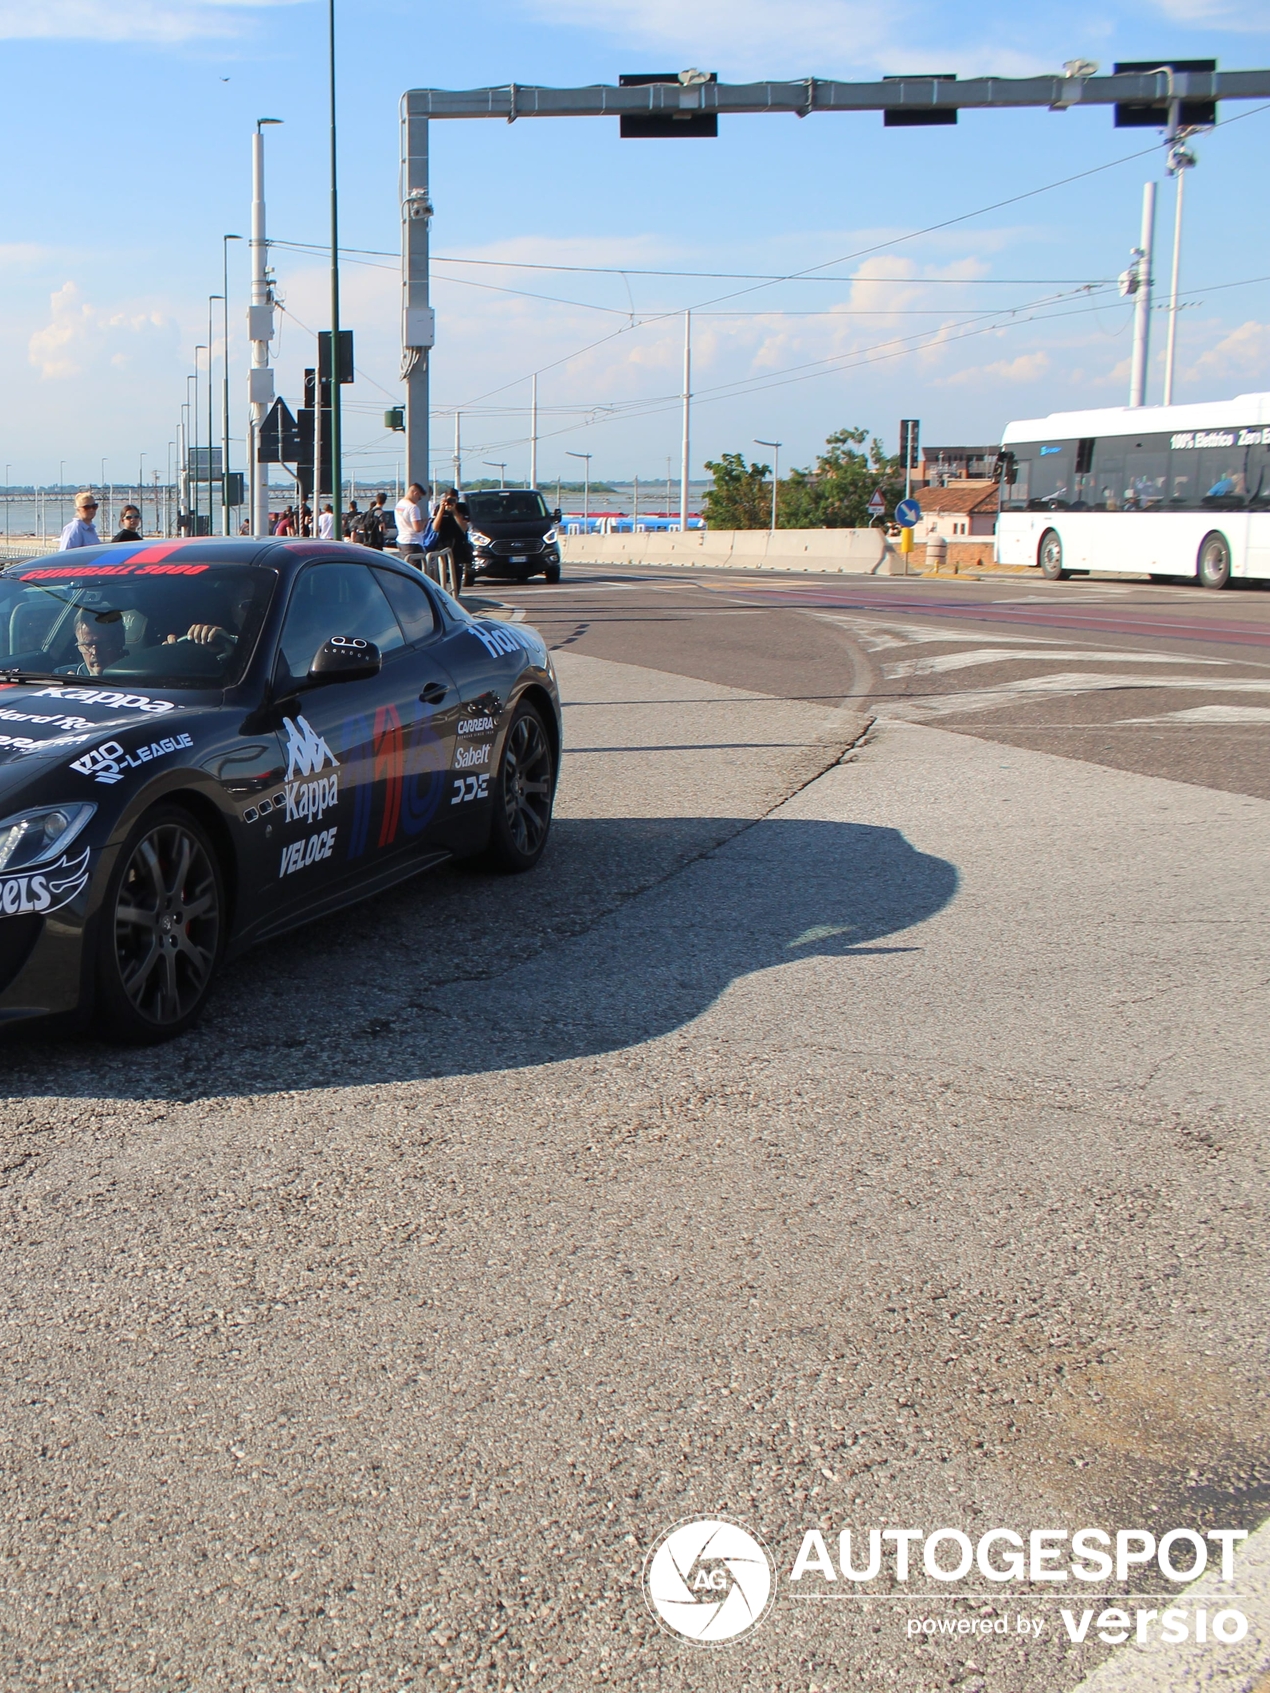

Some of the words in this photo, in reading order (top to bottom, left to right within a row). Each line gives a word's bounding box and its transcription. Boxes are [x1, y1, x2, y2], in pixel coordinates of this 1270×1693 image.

[1170, 432, 1194, 449] 100%
[1194, 431, 1234, 448] Elettrico
[1237, 428, 1261, 446] Zero
[19, 565, 137, 581] GUMBALL
[134, 564, 210, 576] 3000
[324, 648, 370, 661] LONDON
[28, 687, 175, 713] Kappa
[457, 716, 494, 734] CARRERA
[455, 744, 490, 769] Sabelt
[284, 774, 339, 824] Kappa
[279, 826, 338, 878] VELOCE
